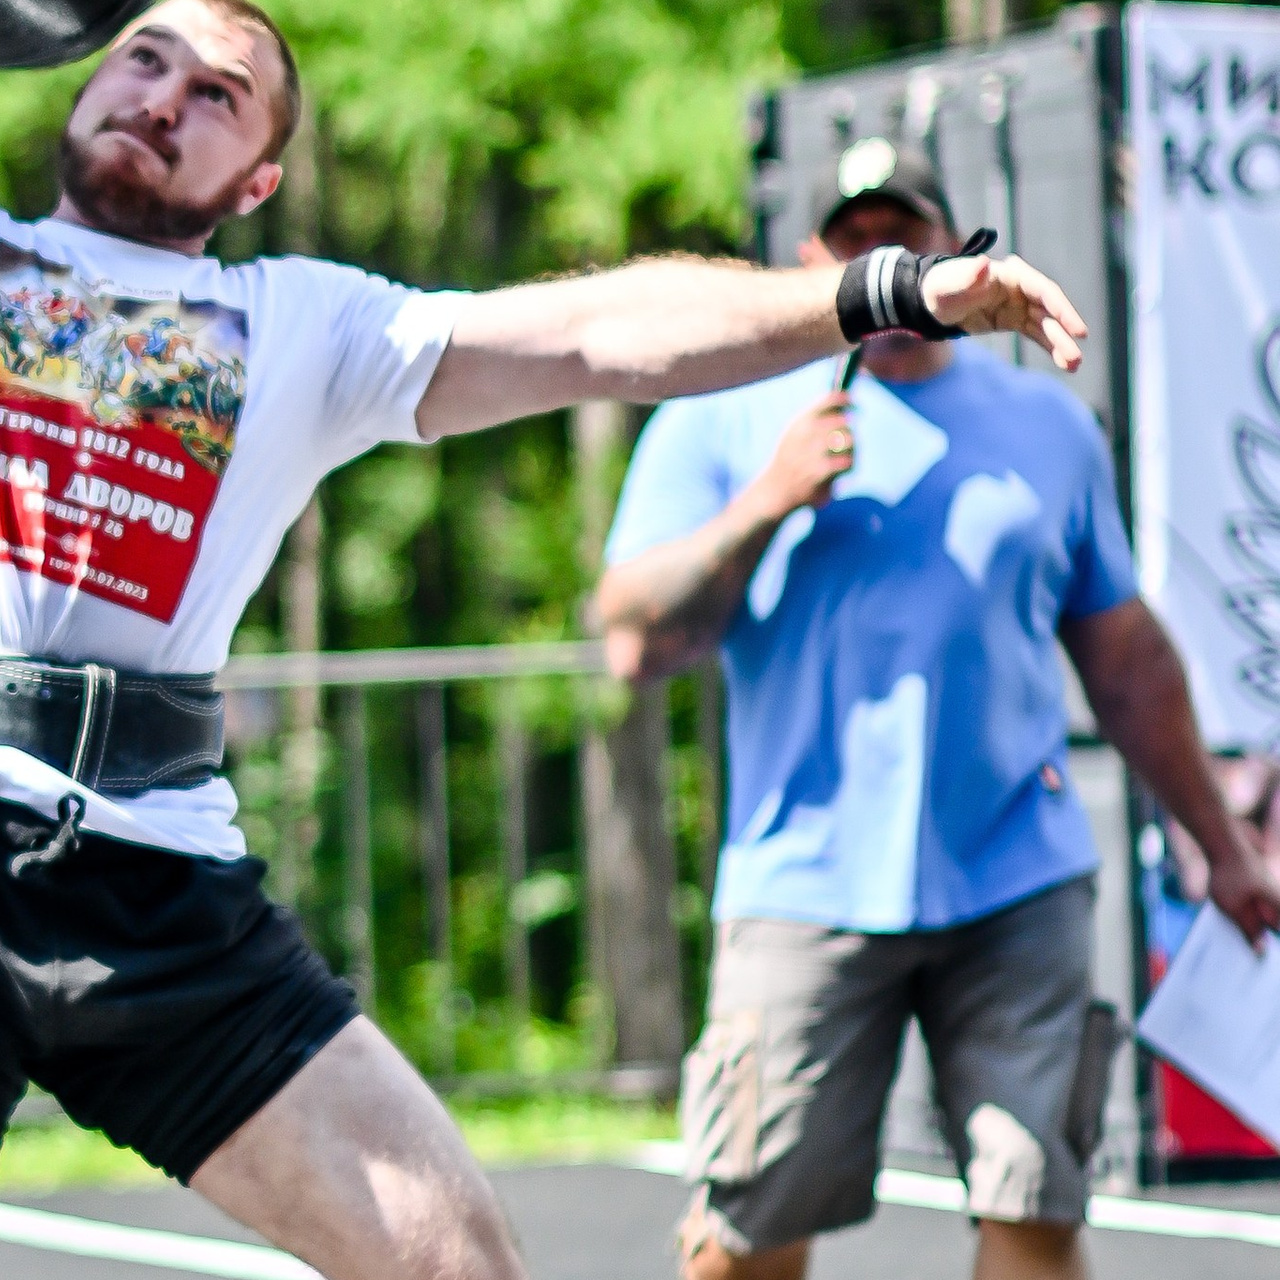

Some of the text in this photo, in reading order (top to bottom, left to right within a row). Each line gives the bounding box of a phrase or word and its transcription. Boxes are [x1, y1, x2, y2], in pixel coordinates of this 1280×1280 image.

[83, 429, 131, 459] 1812
[136, 449, 185, 480] ГОДА
[63, 473, 195, 541] ДВОРОВ
[79, 564, 149, 601] 9.07.2023
